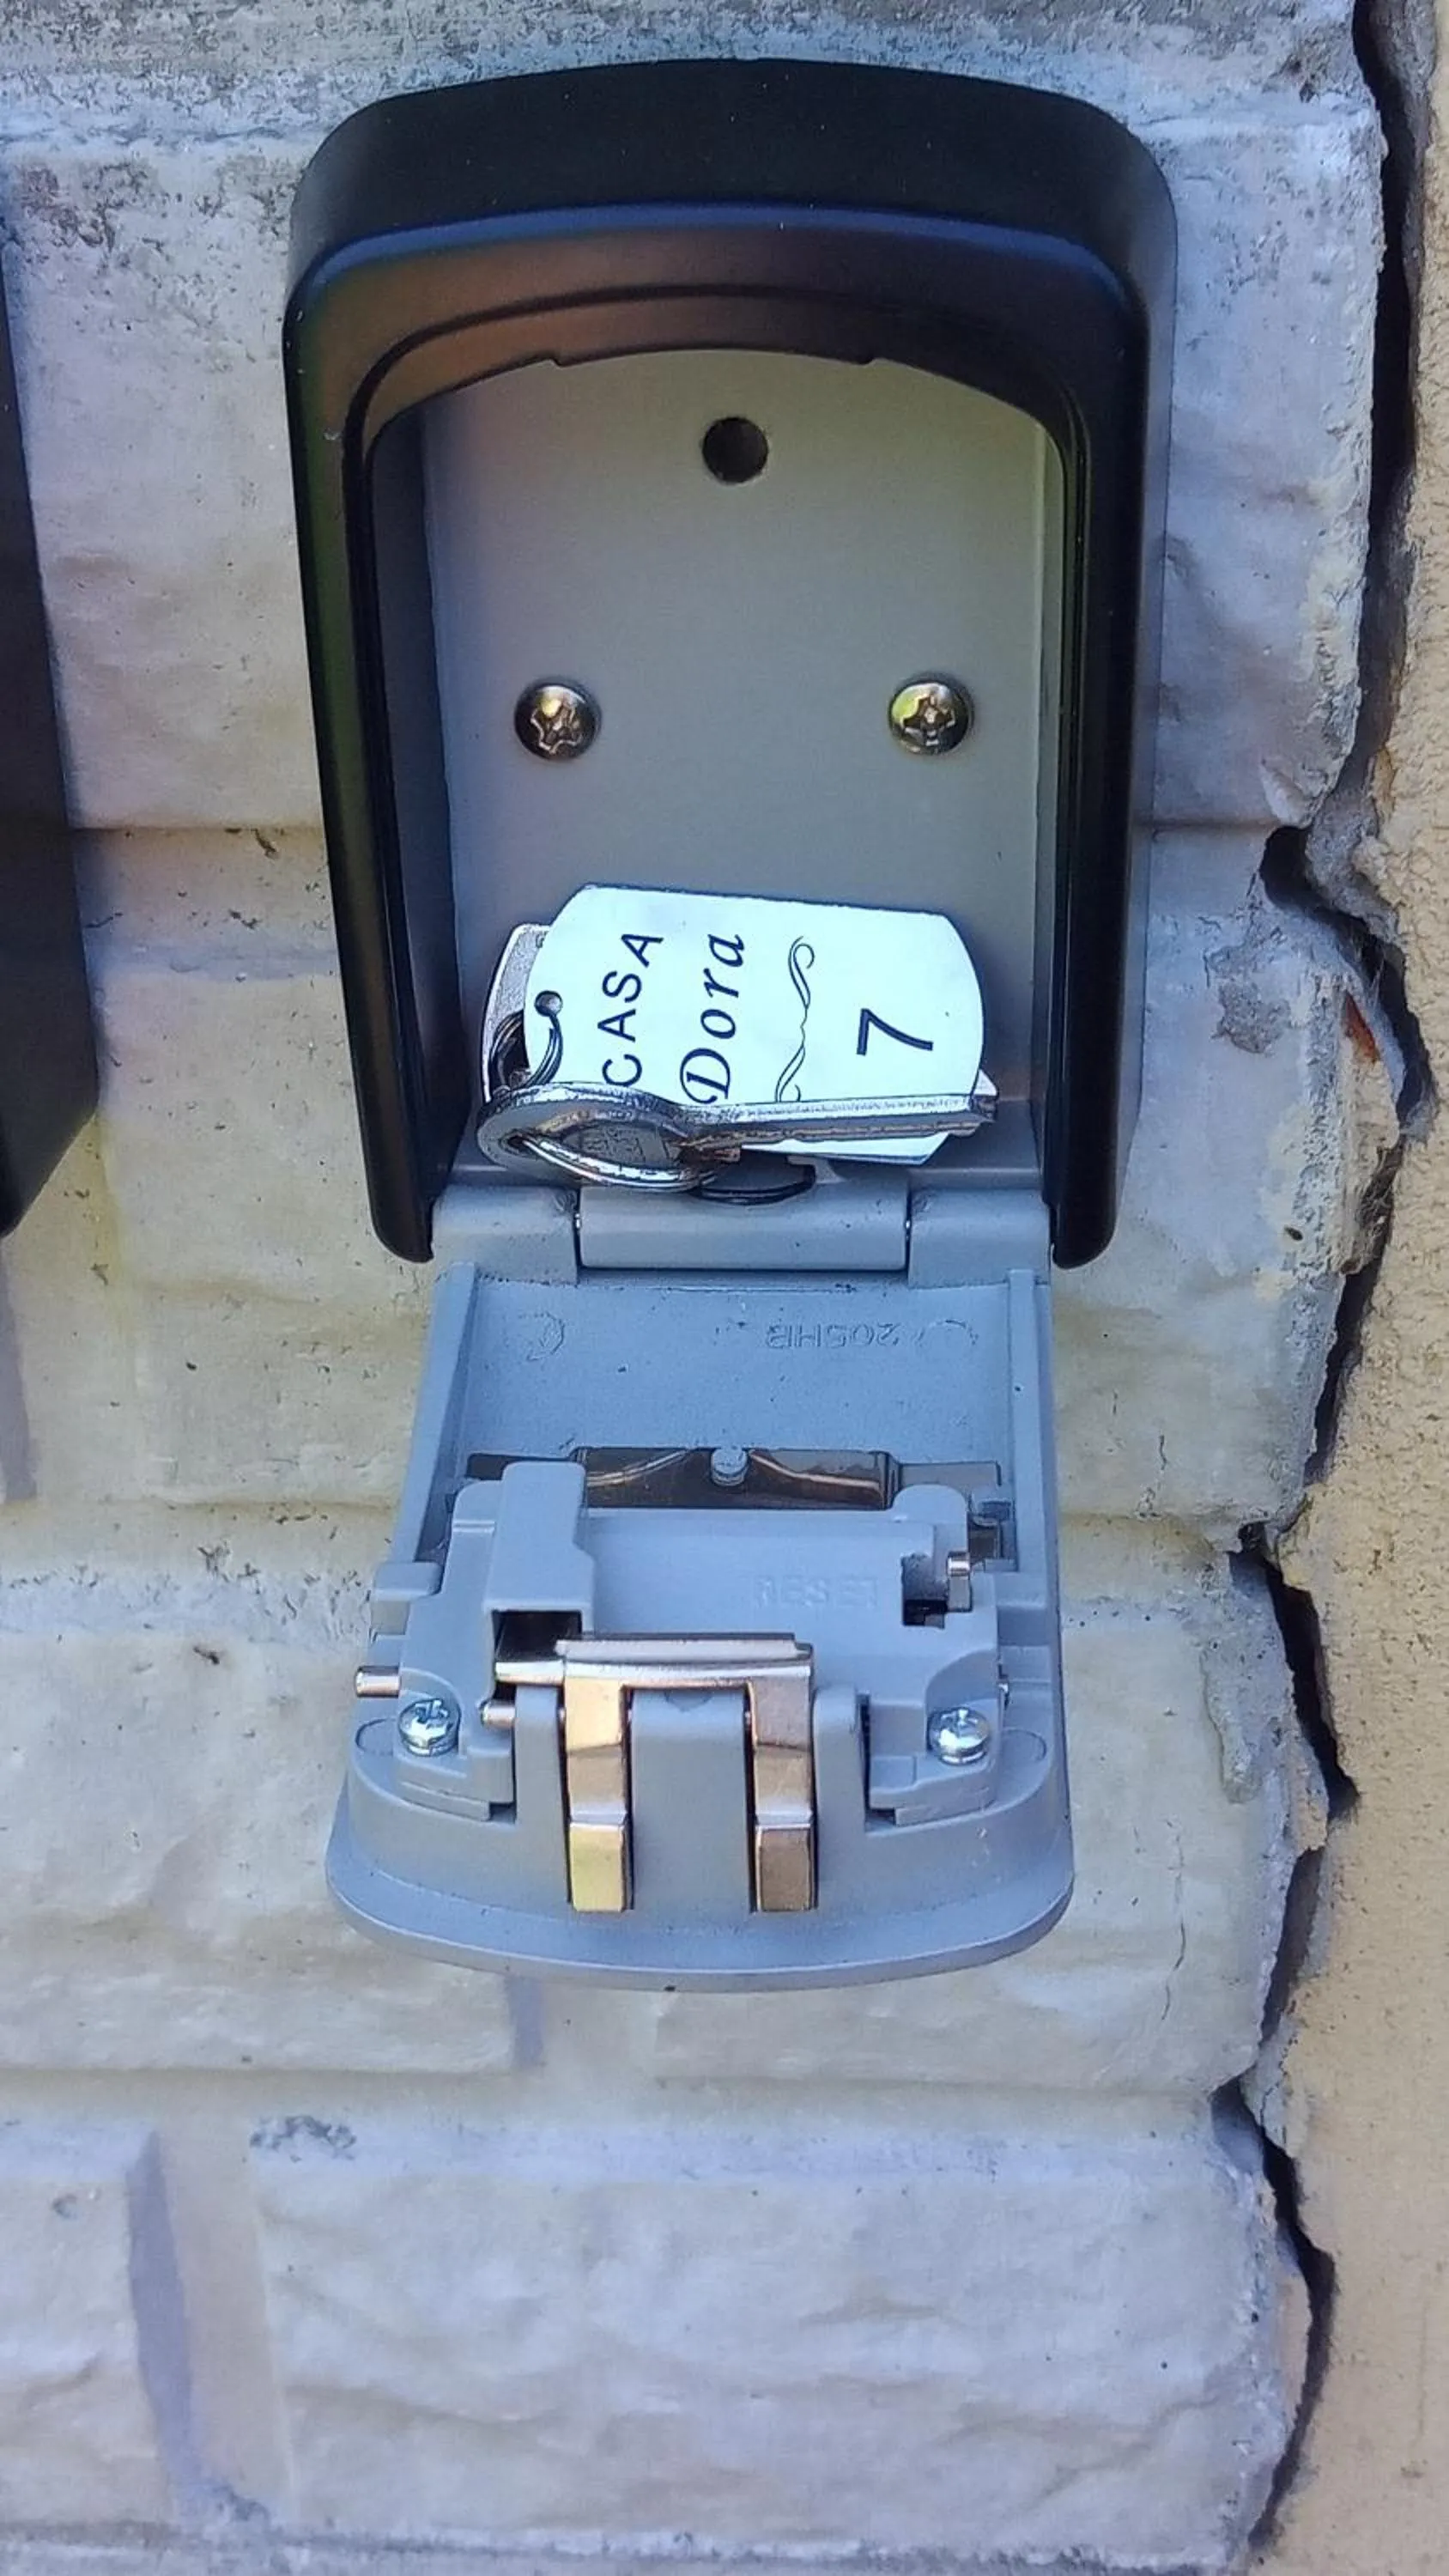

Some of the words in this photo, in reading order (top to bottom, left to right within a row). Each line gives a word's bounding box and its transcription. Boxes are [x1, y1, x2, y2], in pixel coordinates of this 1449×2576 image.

[597, 933, 664, 1087] CASA
[679, 933, 745, 1104] Dora
[856, 1008, 934, 1056] 7
